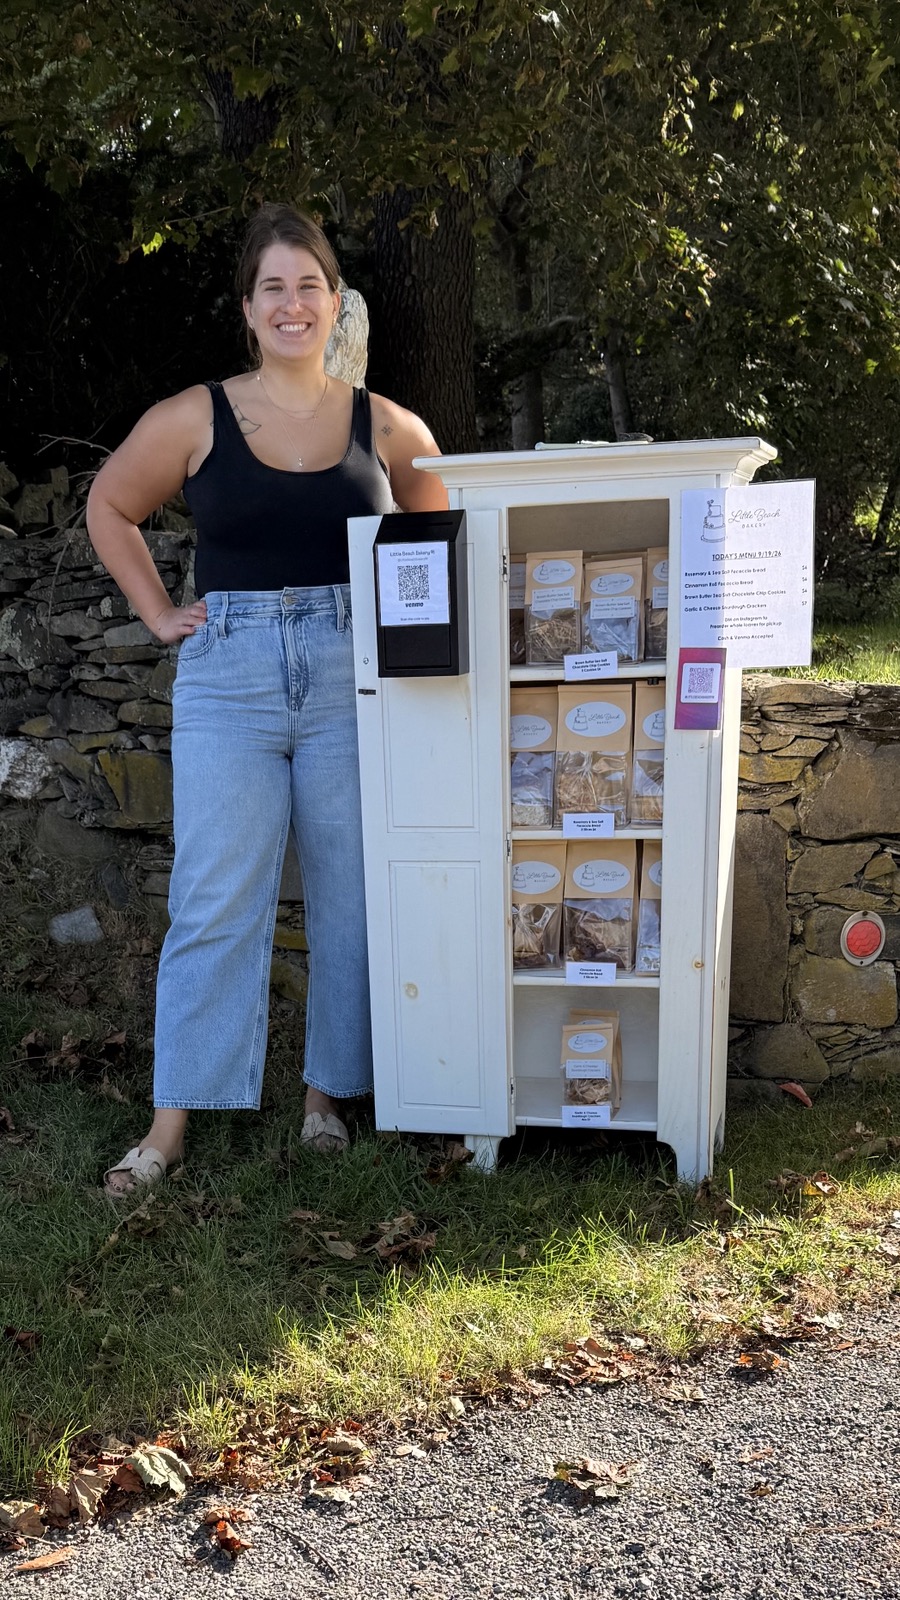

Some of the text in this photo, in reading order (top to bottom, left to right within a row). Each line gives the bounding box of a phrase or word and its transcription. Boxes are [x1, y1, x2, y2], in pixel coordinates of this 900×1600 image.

[728, 508, 780, 523] Little Beach
[757, 550, 782, 558] 9/19/26
